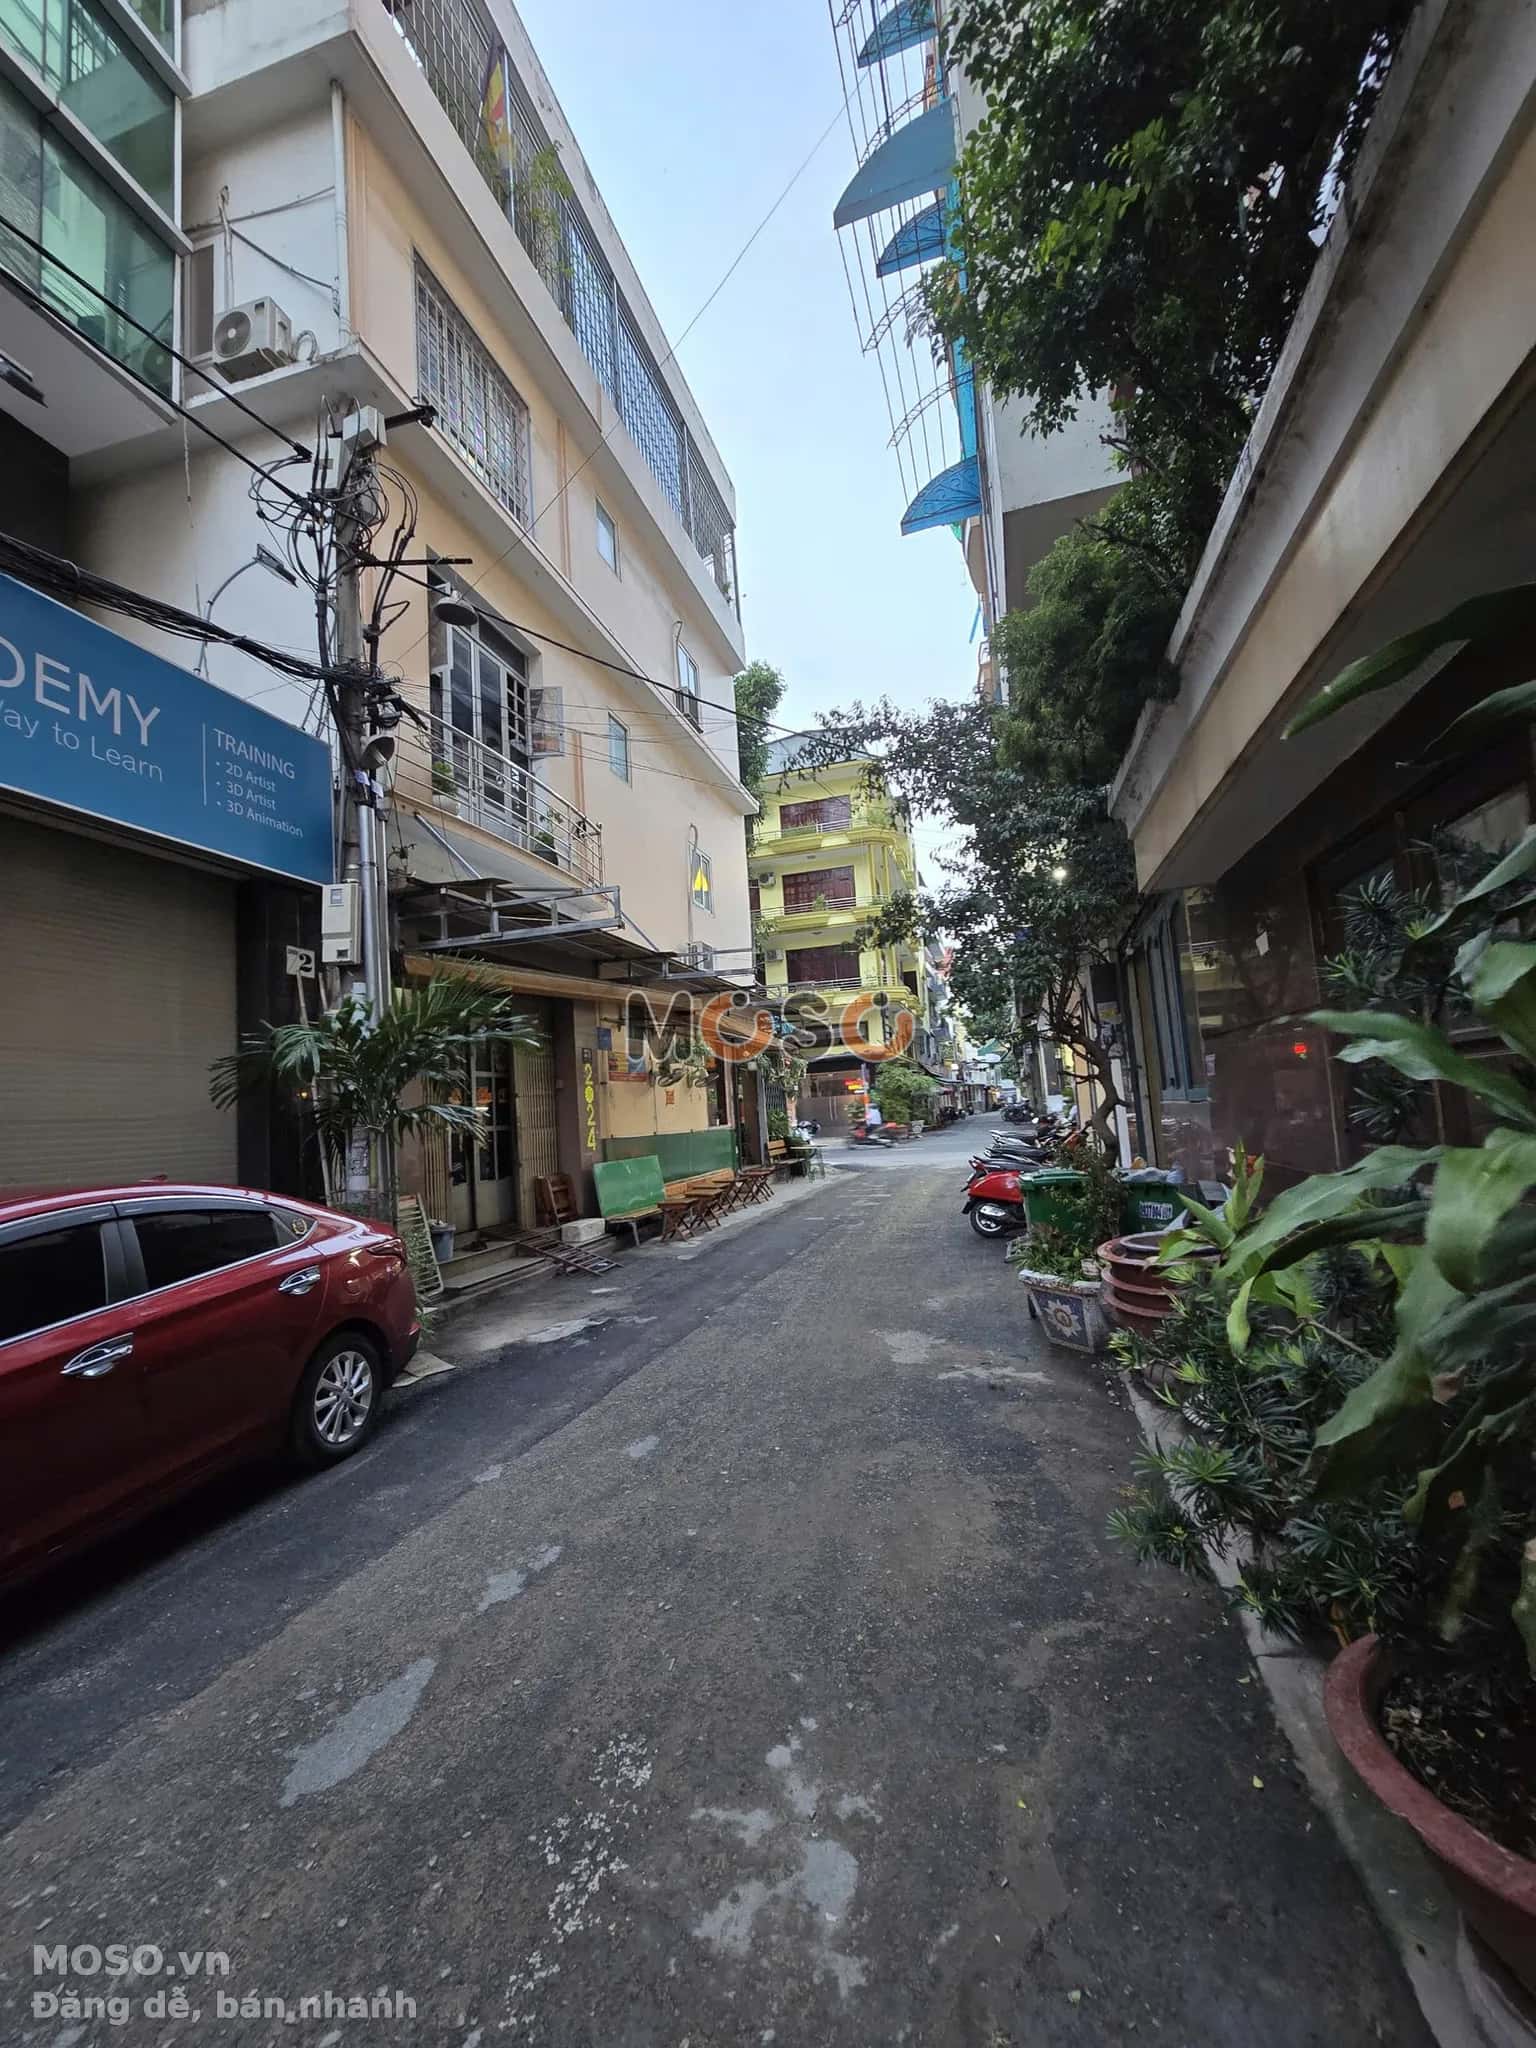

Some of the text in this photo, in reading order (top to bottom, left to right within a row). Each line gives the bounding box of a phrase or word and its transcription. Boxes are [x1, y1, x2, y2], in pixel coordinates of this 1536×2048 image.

[0, 700, 163, 783] ay to Learn
[213, 728, 295, 780] TRAINING
[225, 761, 277, 793] 2D Artist
[226, 780, 277, 811] 3D Artist
[226, 799, 304, 839] 3D Animation
